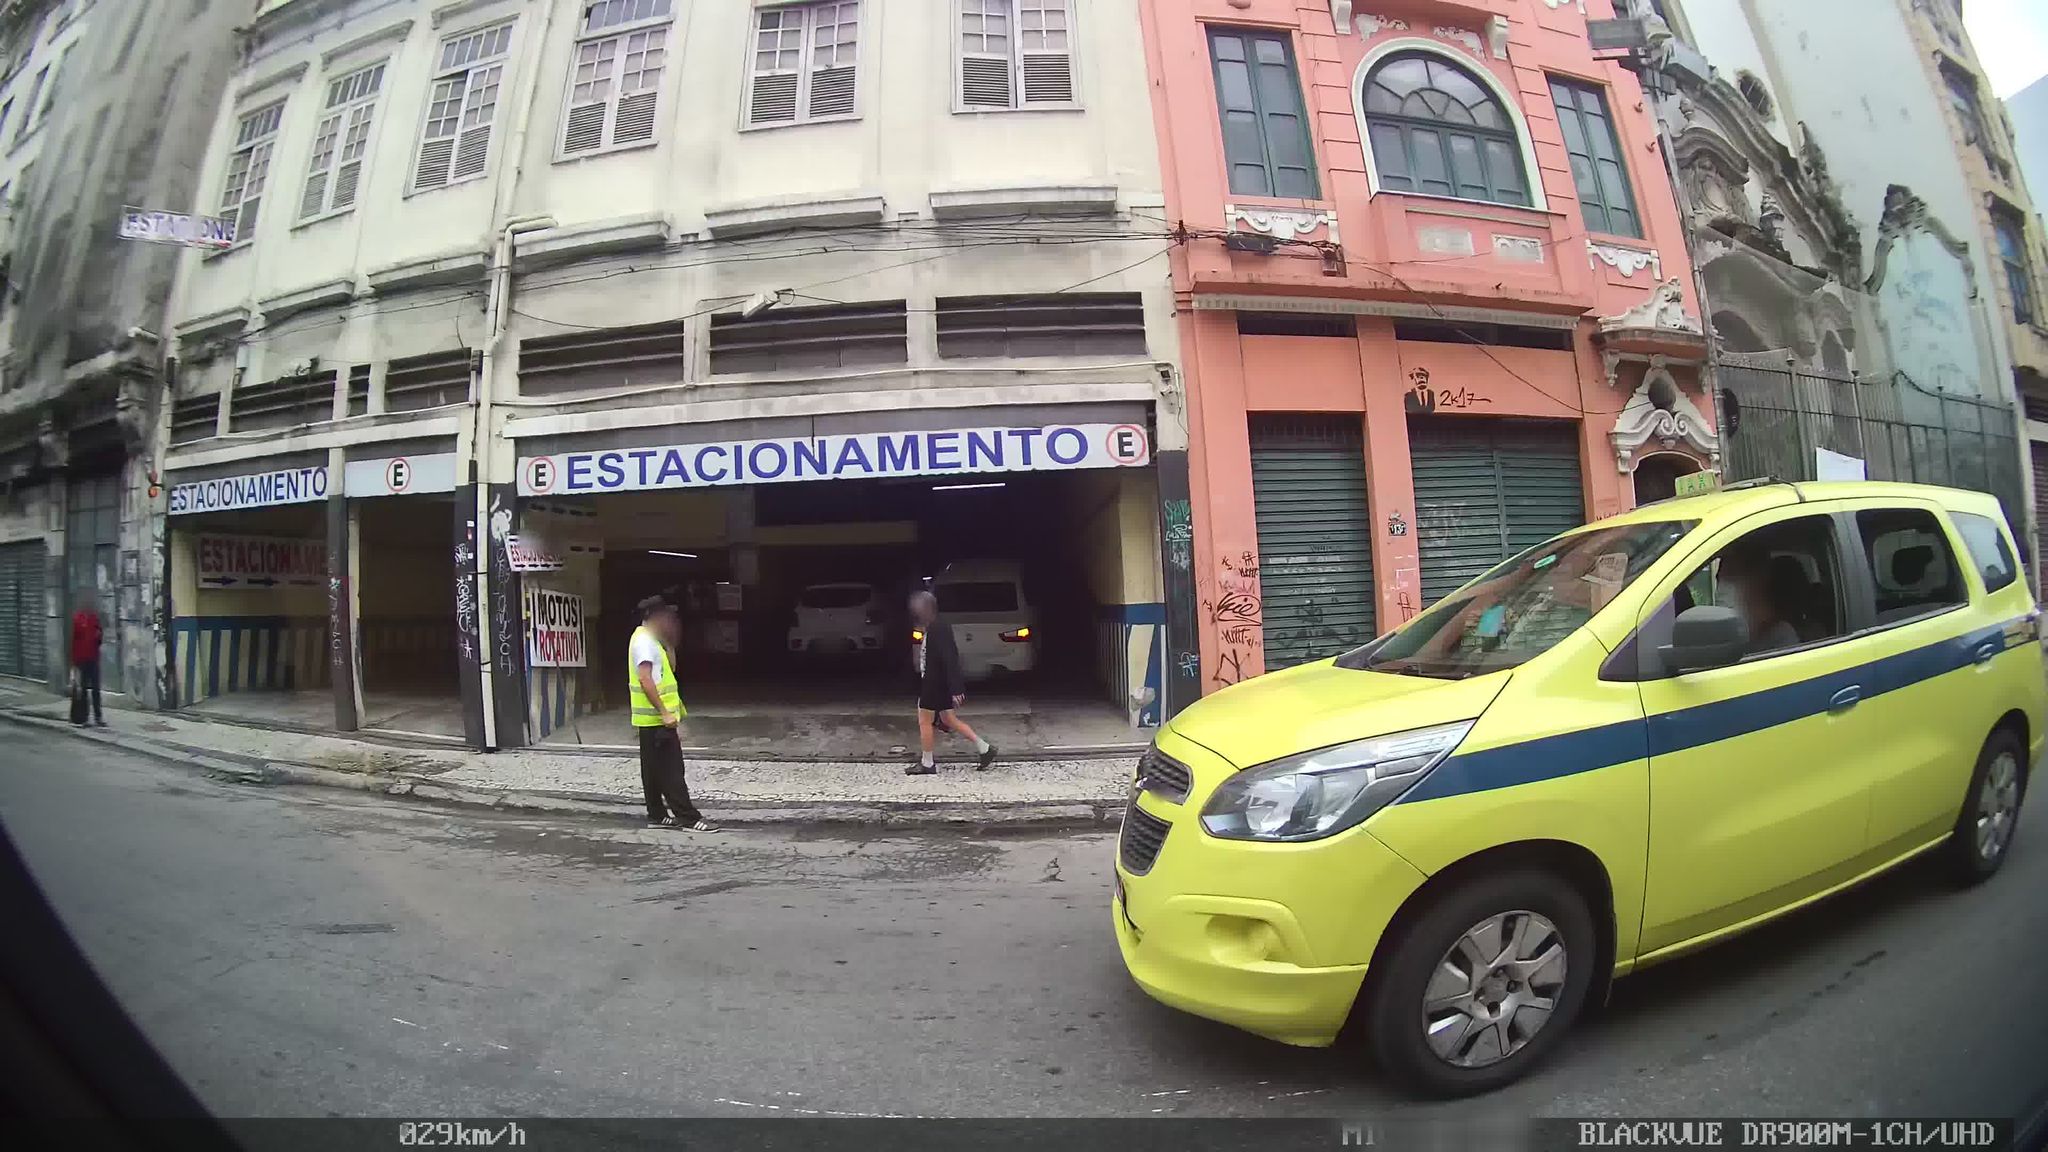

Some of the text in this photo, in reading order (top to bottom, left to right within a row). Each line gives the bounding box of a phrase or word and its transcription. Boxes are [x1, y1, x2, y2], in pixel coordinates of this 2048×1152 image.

[534, 426, 1136, 491] E ESTACIONAMENTO E
[170, 463, 405, 512] ESTACIONAMENTO E
[201, 537, 328, 575] ESTACIONAME
[537, 592, 578, 629] MOTOS
[539, 630, 580, 662] ROTATIVO
